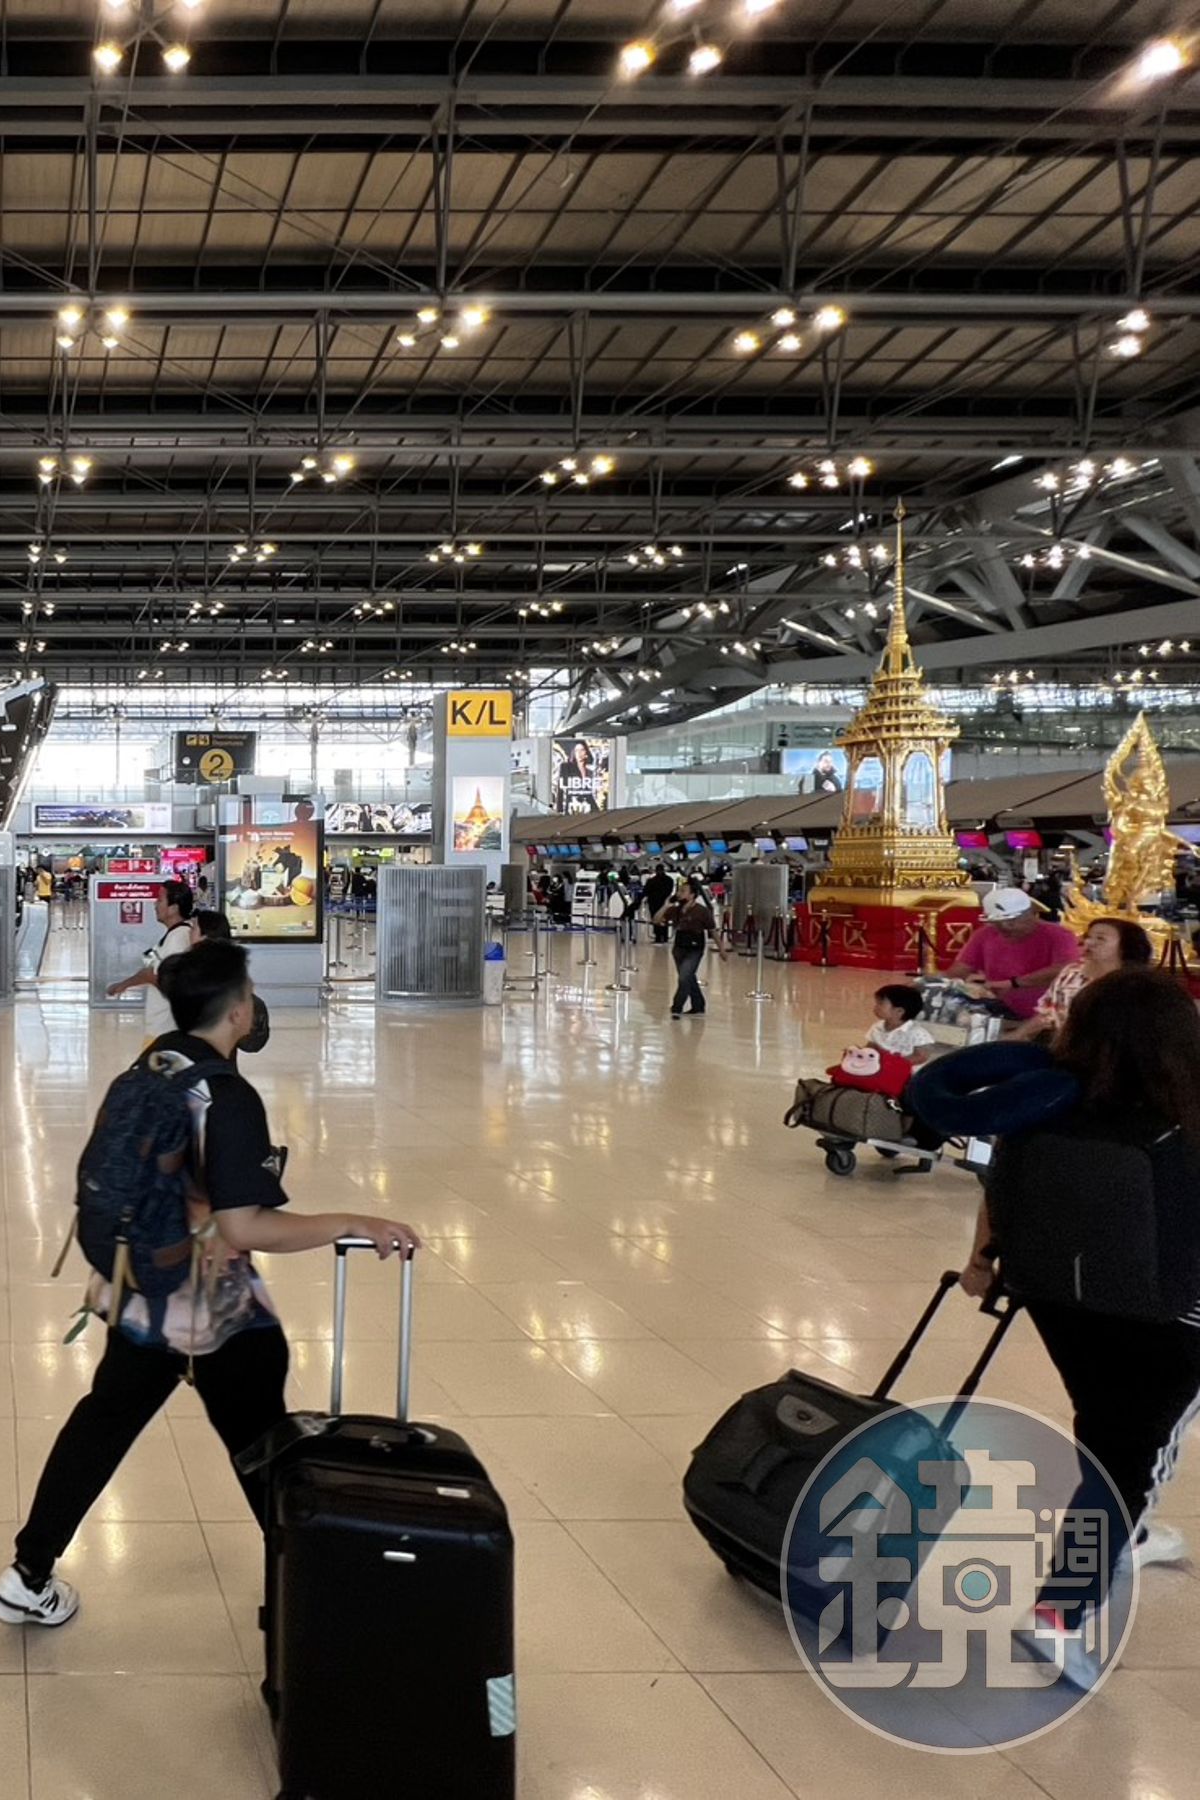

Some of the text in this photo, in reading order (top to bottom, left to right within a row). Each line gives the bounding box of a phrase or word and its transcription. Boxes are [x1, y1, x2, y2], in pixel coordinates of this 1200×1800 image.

[452, 699, 507, 725] K/L
[208, 753, 225, 777] 2
[560, 776, 603, 789] LIBRE
